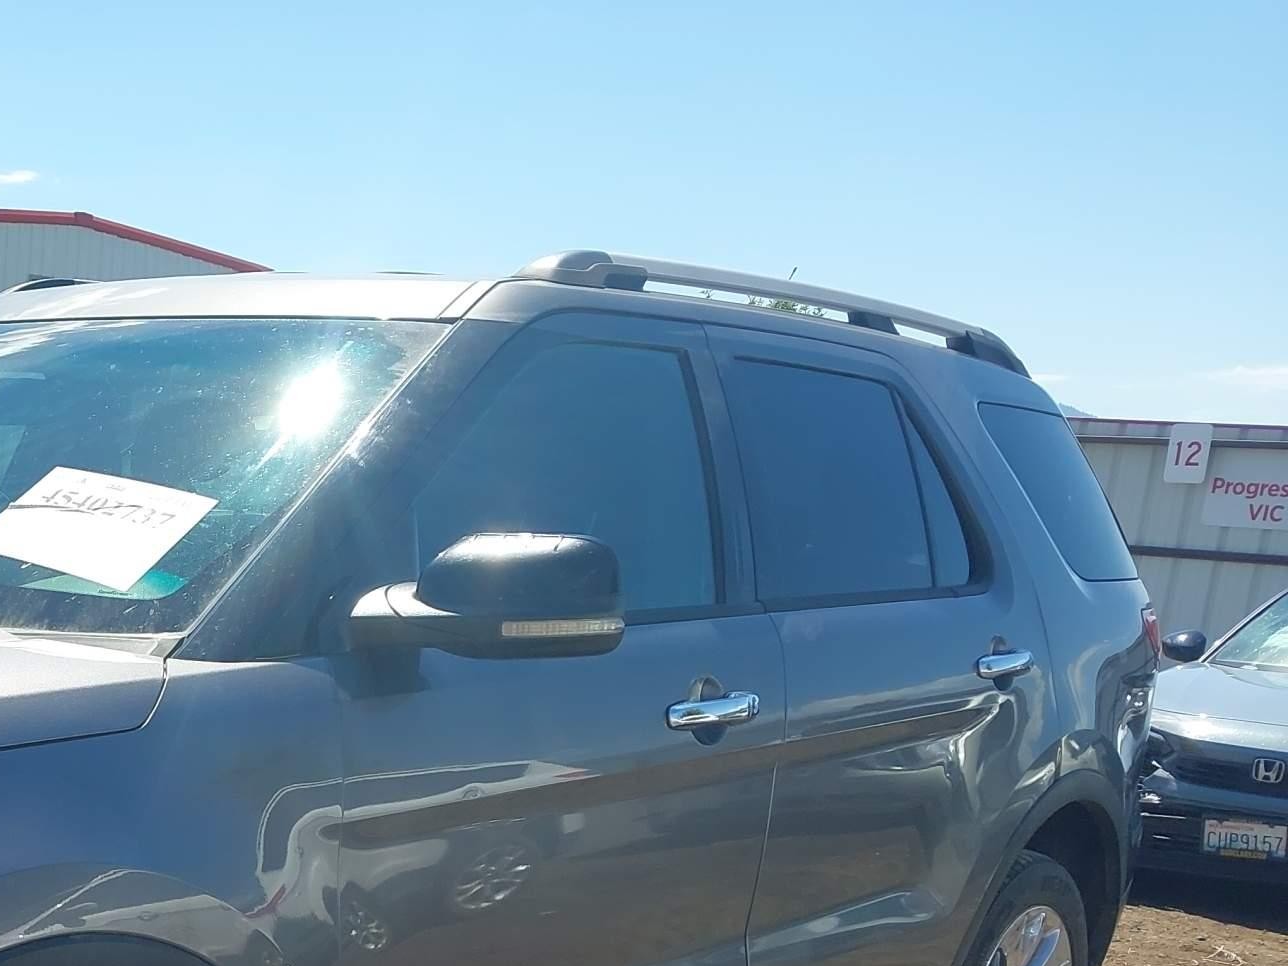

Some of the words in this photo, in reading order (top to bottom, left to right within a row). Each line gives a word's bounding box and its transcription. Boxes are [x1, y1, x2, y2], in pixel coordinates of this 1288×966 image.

[1174, 441, 1202, 466] 12
[1211, 477, 1288, 499] Progres
[1249, 503, 1285, 522] VIC
